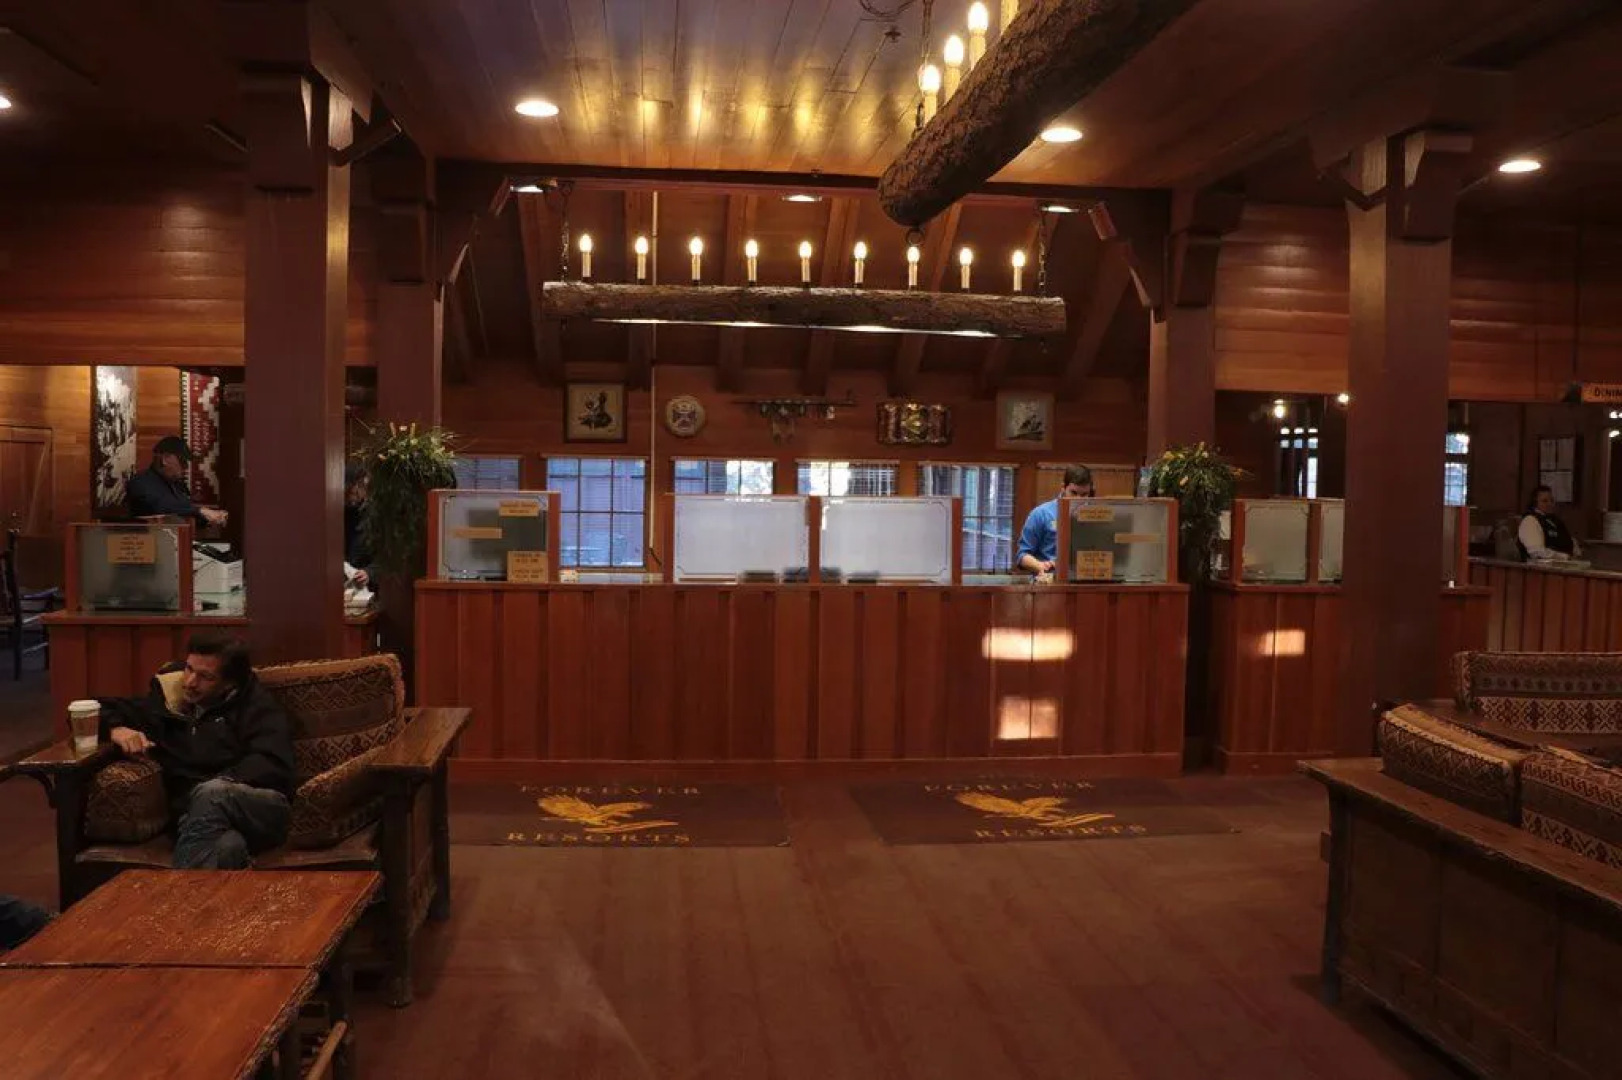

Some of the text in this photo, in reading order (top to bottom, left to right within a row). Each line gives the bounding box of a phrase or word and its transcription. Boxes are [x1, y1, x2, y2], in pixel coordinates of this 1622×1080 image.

[521, 784, 701, 795] FOREVER
[974, 824, 1148, 839] RESORTS
[507, 832, 691, 844] RESORTS
